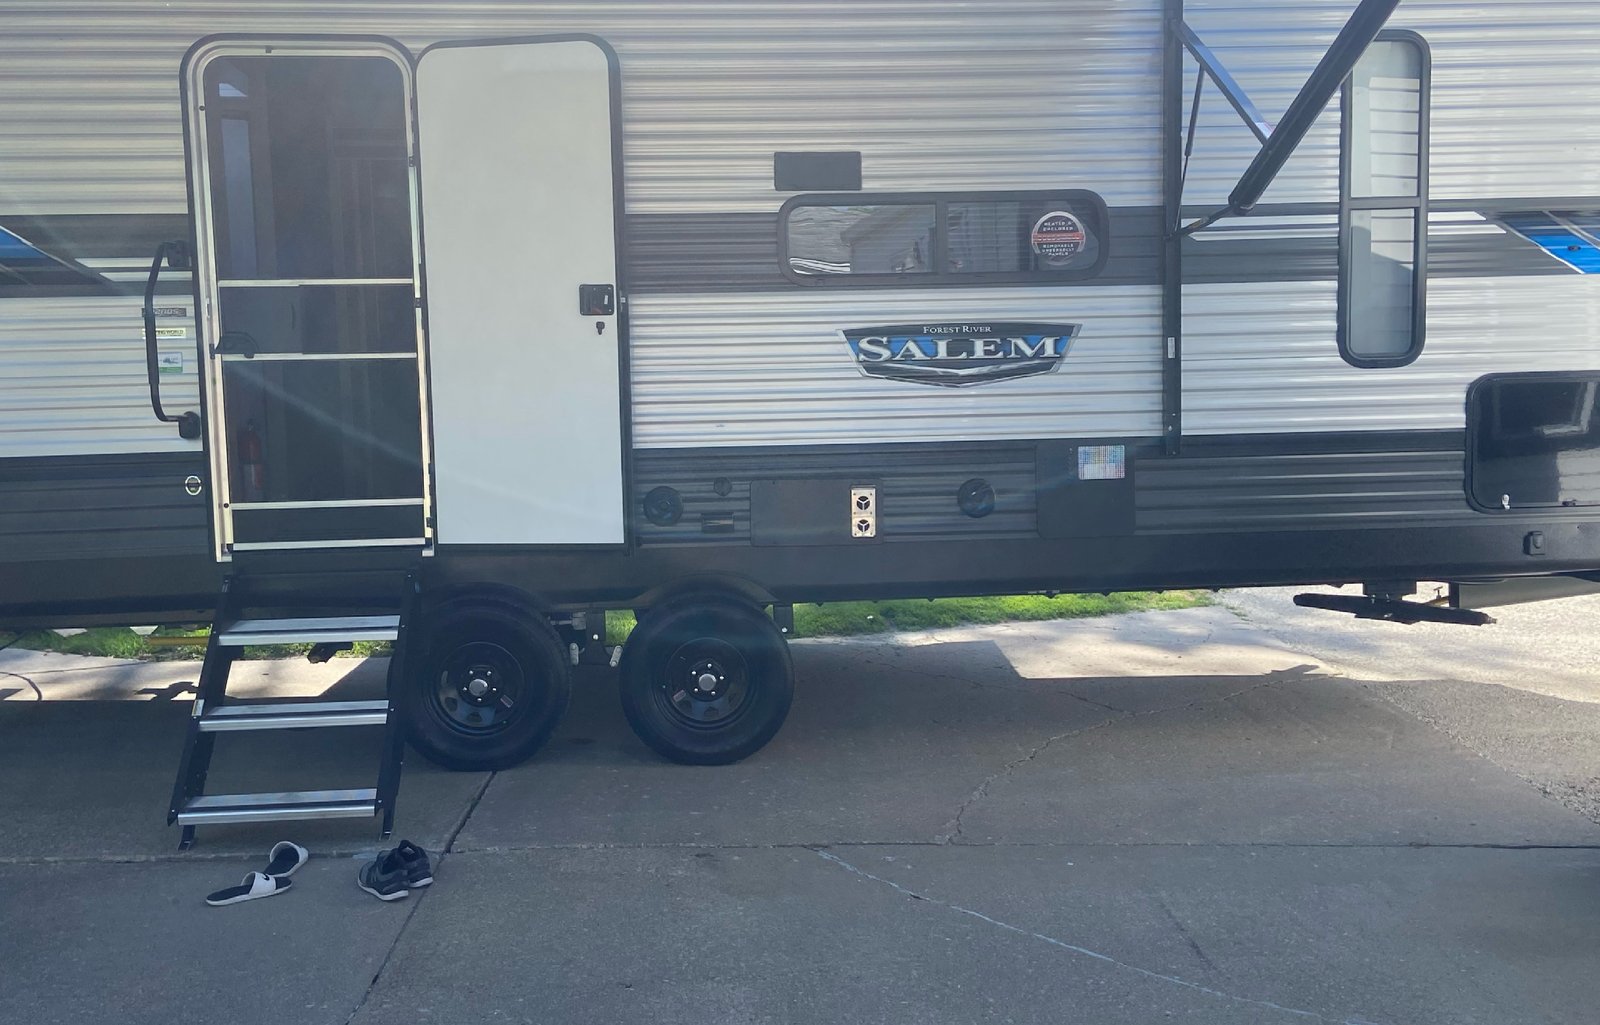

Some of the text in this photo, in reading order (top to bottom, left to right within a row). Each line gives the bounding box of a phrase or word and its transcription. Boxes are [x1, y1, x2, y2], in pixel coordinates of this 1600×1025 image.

[922, 325, 992, 334] FOREST RIVER
[858, 335, 1061, 362] SALEM
